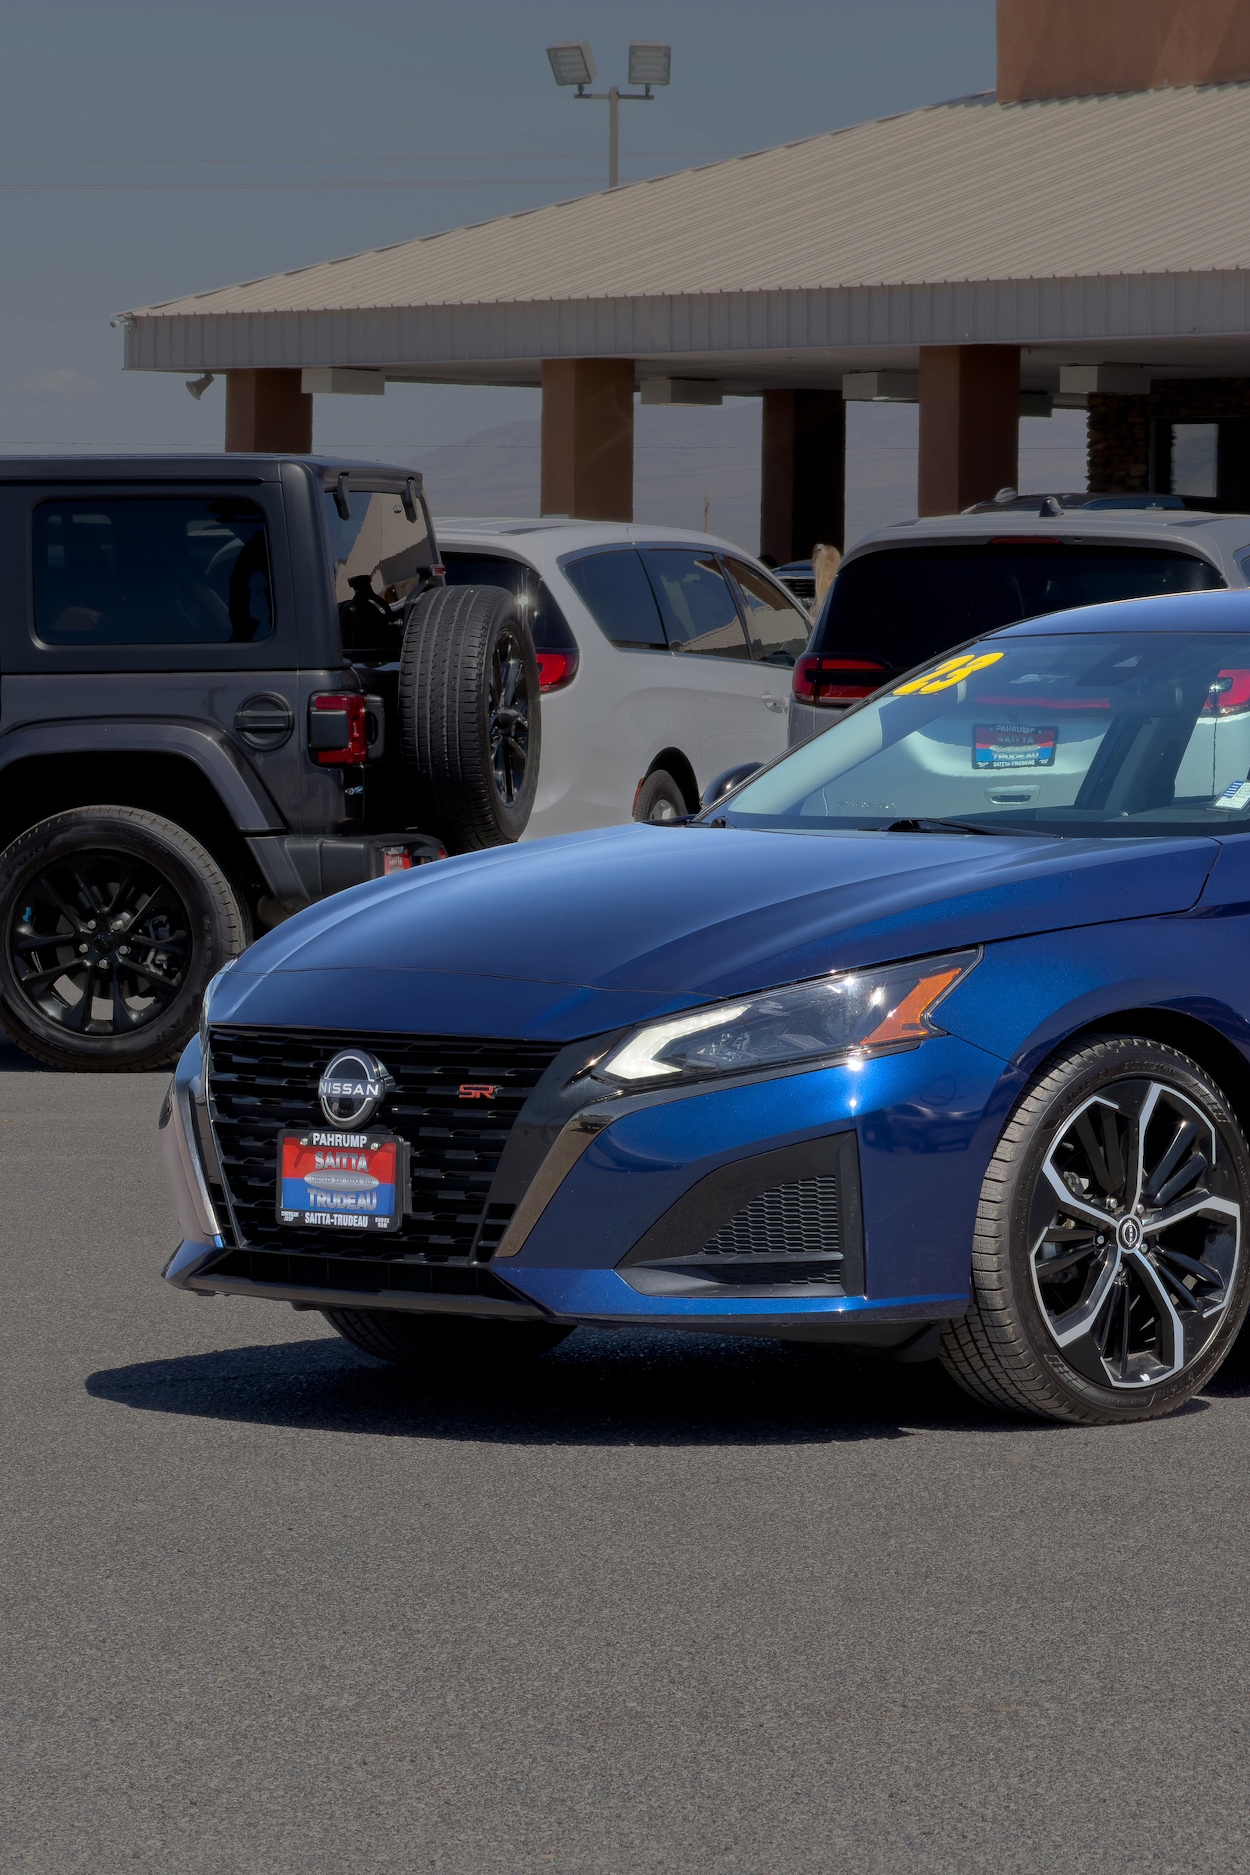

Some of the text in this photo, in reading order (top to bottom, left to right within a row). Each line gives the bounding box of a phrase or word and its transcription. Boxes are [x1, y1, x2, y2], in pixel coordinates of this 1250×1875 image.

[996, 724, 1035, 734] PAHRUMP
[319, 1081, 379, 1096] NISSAN
[459, 1084, 494, 1098] SR
[312, 1132, 368, 1148] PAHRUMP
[314, 1150, 369, 1172] SAITTA
[306, 1187, 377, 1212] TRUDEAU
[305, 1211, 369, 1228] SAITTA-TRUDEAU
